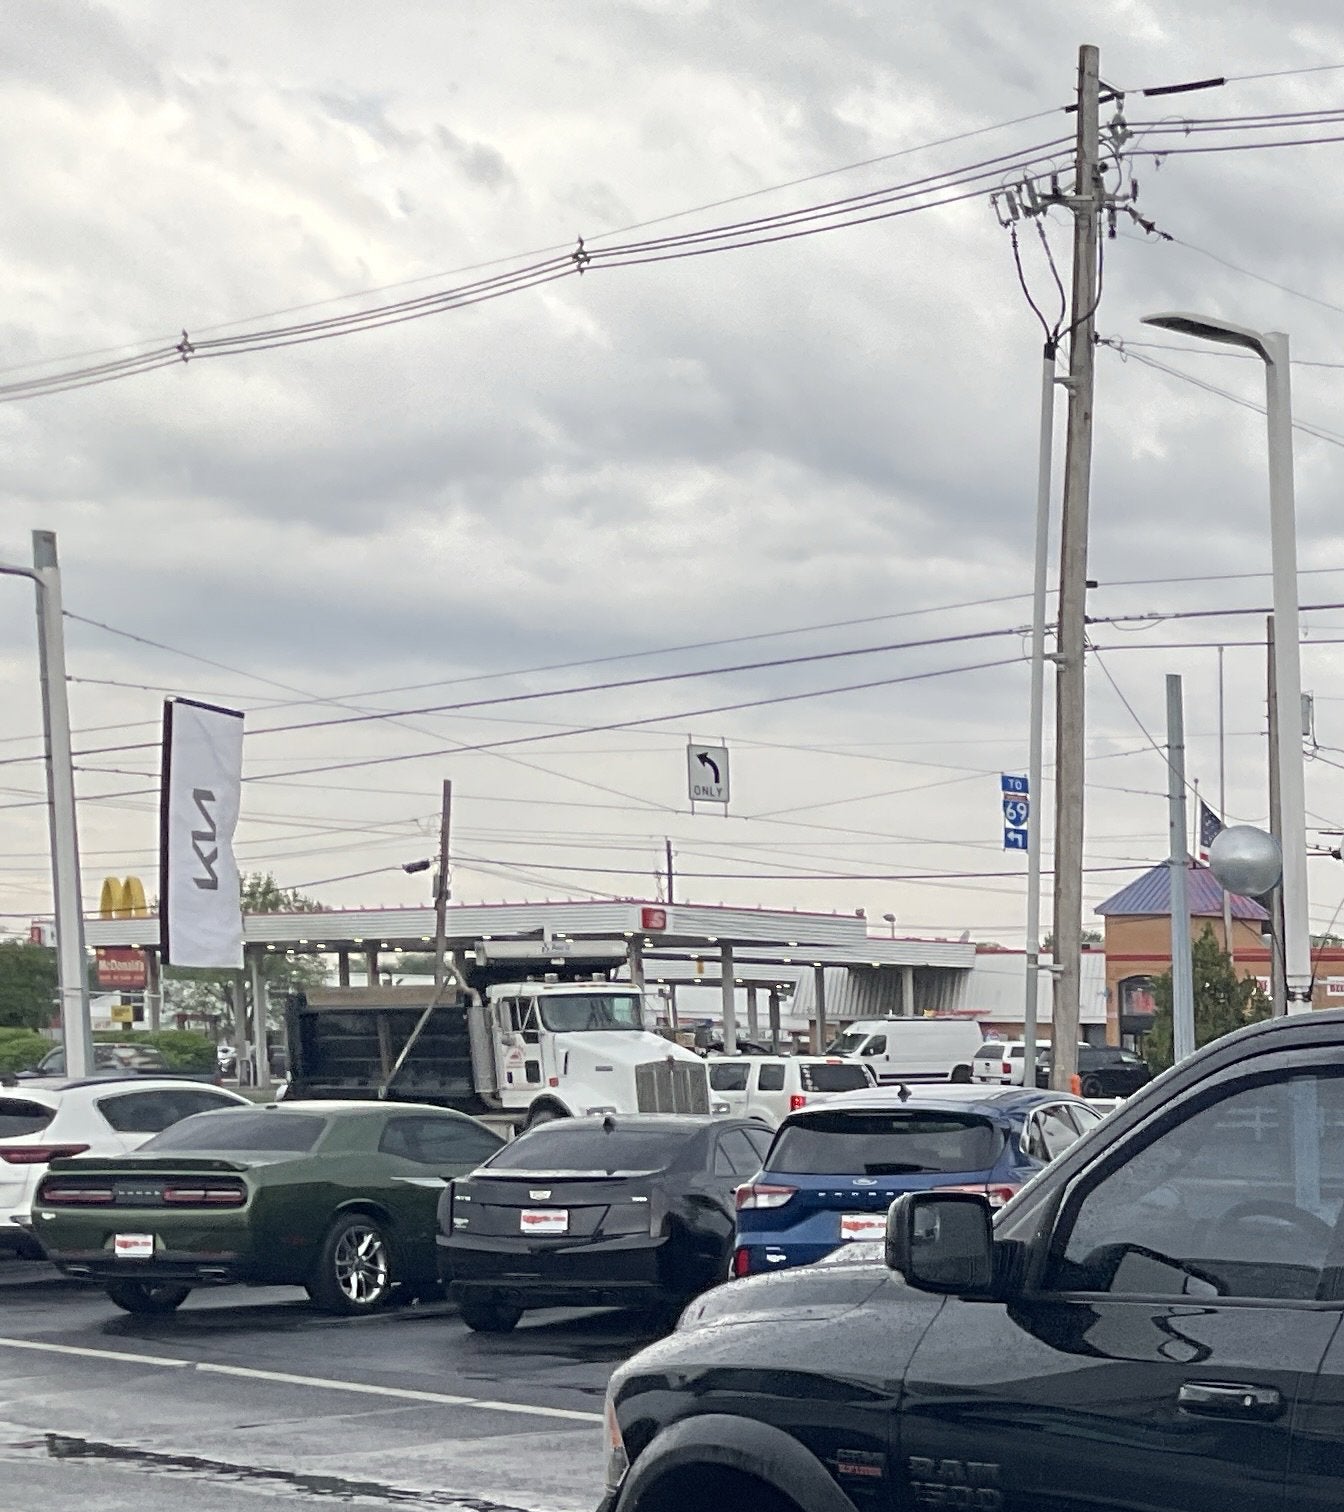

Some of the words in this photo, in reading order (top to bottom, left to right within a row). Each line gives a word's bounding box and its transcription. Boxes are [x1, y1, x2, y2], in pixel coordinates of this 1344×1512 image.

[1007, 779, 1023, 790] TO
[694, 785, 723, 797] ONLY
[1006, 801, 1027, 820] 69
